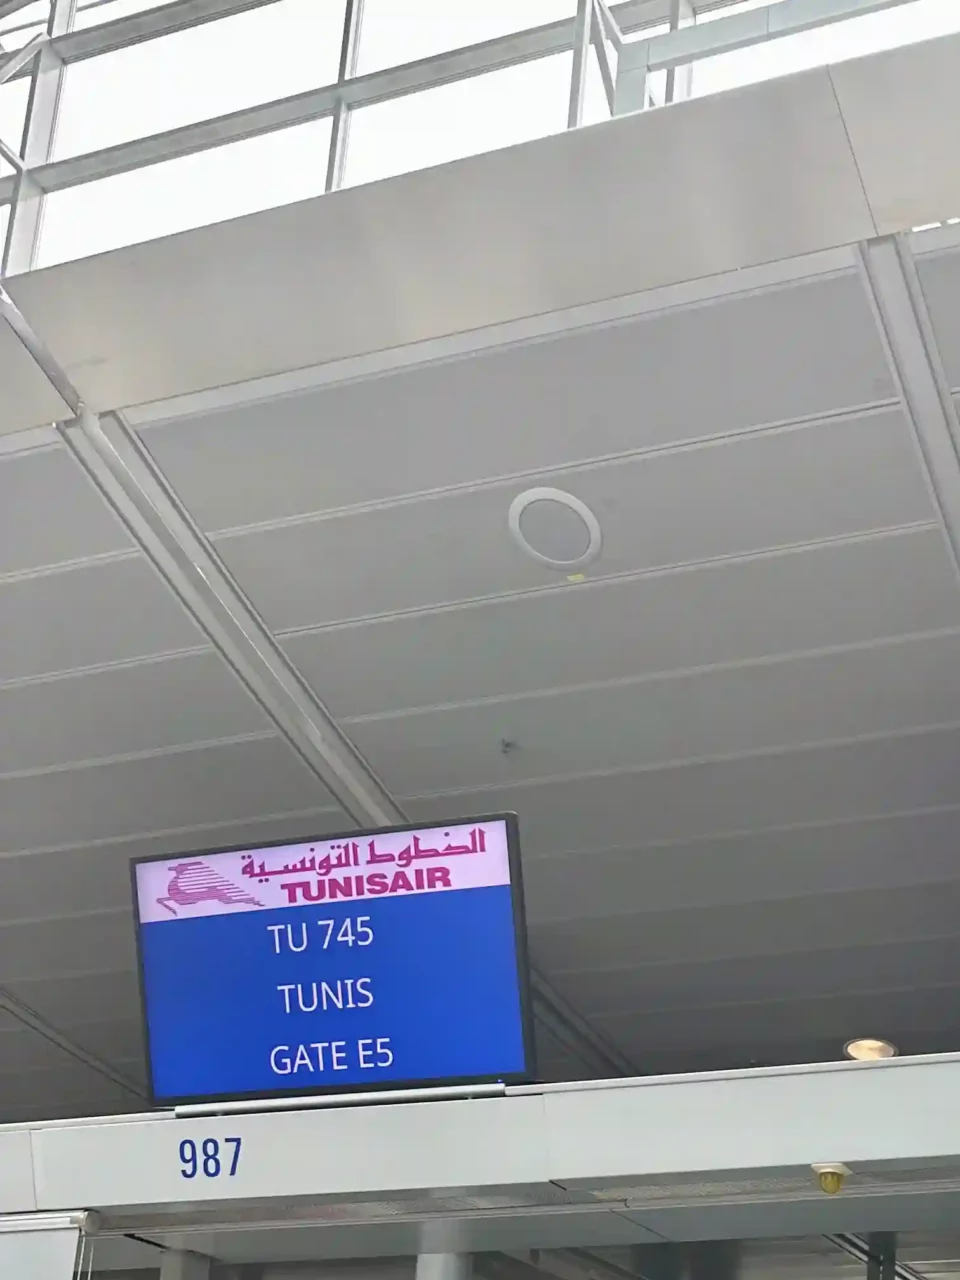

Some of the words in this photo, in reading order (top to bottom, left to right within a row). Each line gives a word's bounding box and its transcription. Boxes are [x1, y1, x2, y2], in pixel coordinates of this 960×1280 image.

[240, 841, 360, 884] التونسية
[280, 866, 453, 904] TUNISAIR
[266, 922, 308, 954] TU
[317, 916, 374, 949] 745
[277, 977, 374, 1013] TUNIS
[270, 1041, 348, 1075] GATE
[358, 1037, 393, 1068] E5
[178, 1137, 242, 1179] 987
